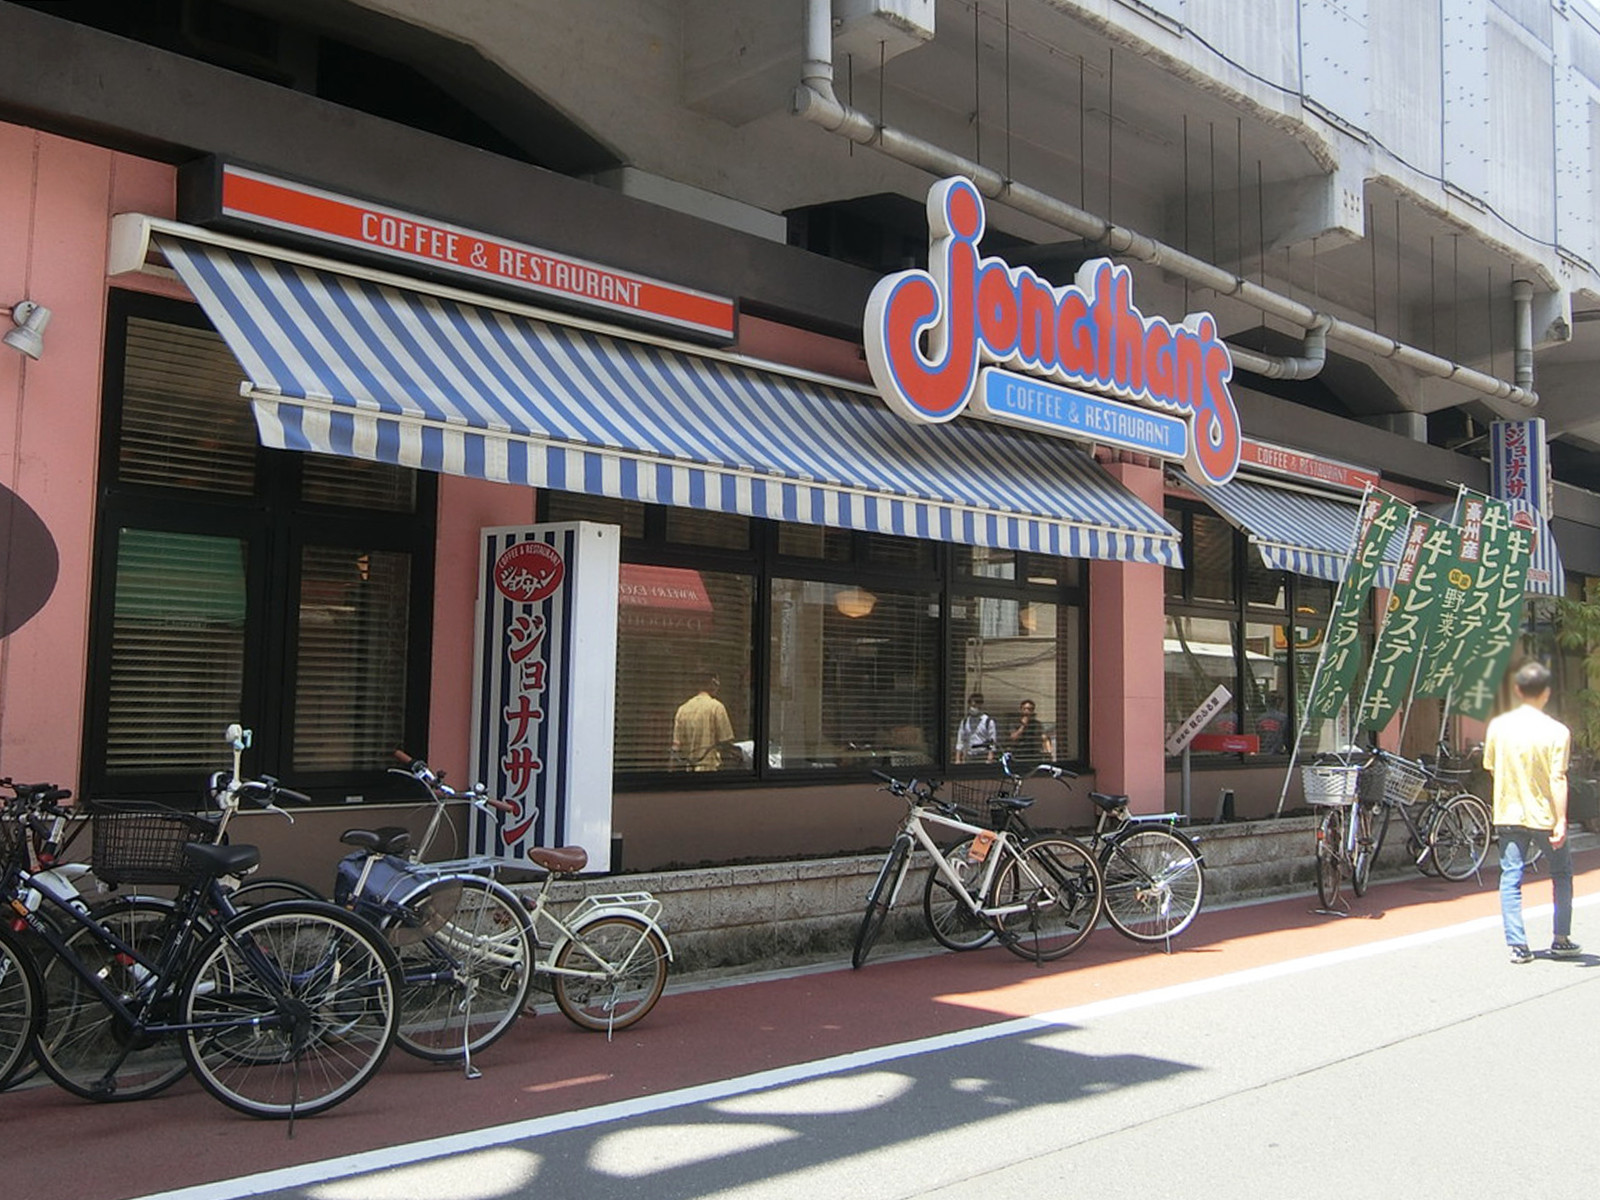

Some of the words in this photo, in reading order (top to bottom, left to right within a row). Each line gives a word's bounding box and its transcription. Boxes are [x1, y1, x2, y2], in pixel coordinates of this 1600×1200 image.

[362, 213, 458, 261] COFFEE
[470, 242, 488, 269] &
[500, 248, 642, 307] RESTAURANT
[880, 180, 1240, 482] jonathan's
[1006, 383, 1062, 419] COFFEE
[1067, 401, 1080, 424] &
[1085, 404, 1169, 446] RESTAURANT
[1257, 447, 1288, 469] COFFEE
[1291, 456, 1299, 471] &
[1300, 457, 1349, 482] RESTAURANT
[1504, 428, 1528, 499] ジョナサ
[498, 547, 519, 569] COFFEE
[1397, 523, 1427, 582] 豪州産
[1459, 502, 1483, 561] 豪州産
[500, 566, 557, 600] ジョナサン
[1434, 506, 1509, 687] 牛ヒレステーキ
[1364, 529, 1453, 720] 牛ヒレステーキ
[1464, 530, 1530, 710] 牛ヒレステーキ
[503, 614, 546, 846] ジョナサン
